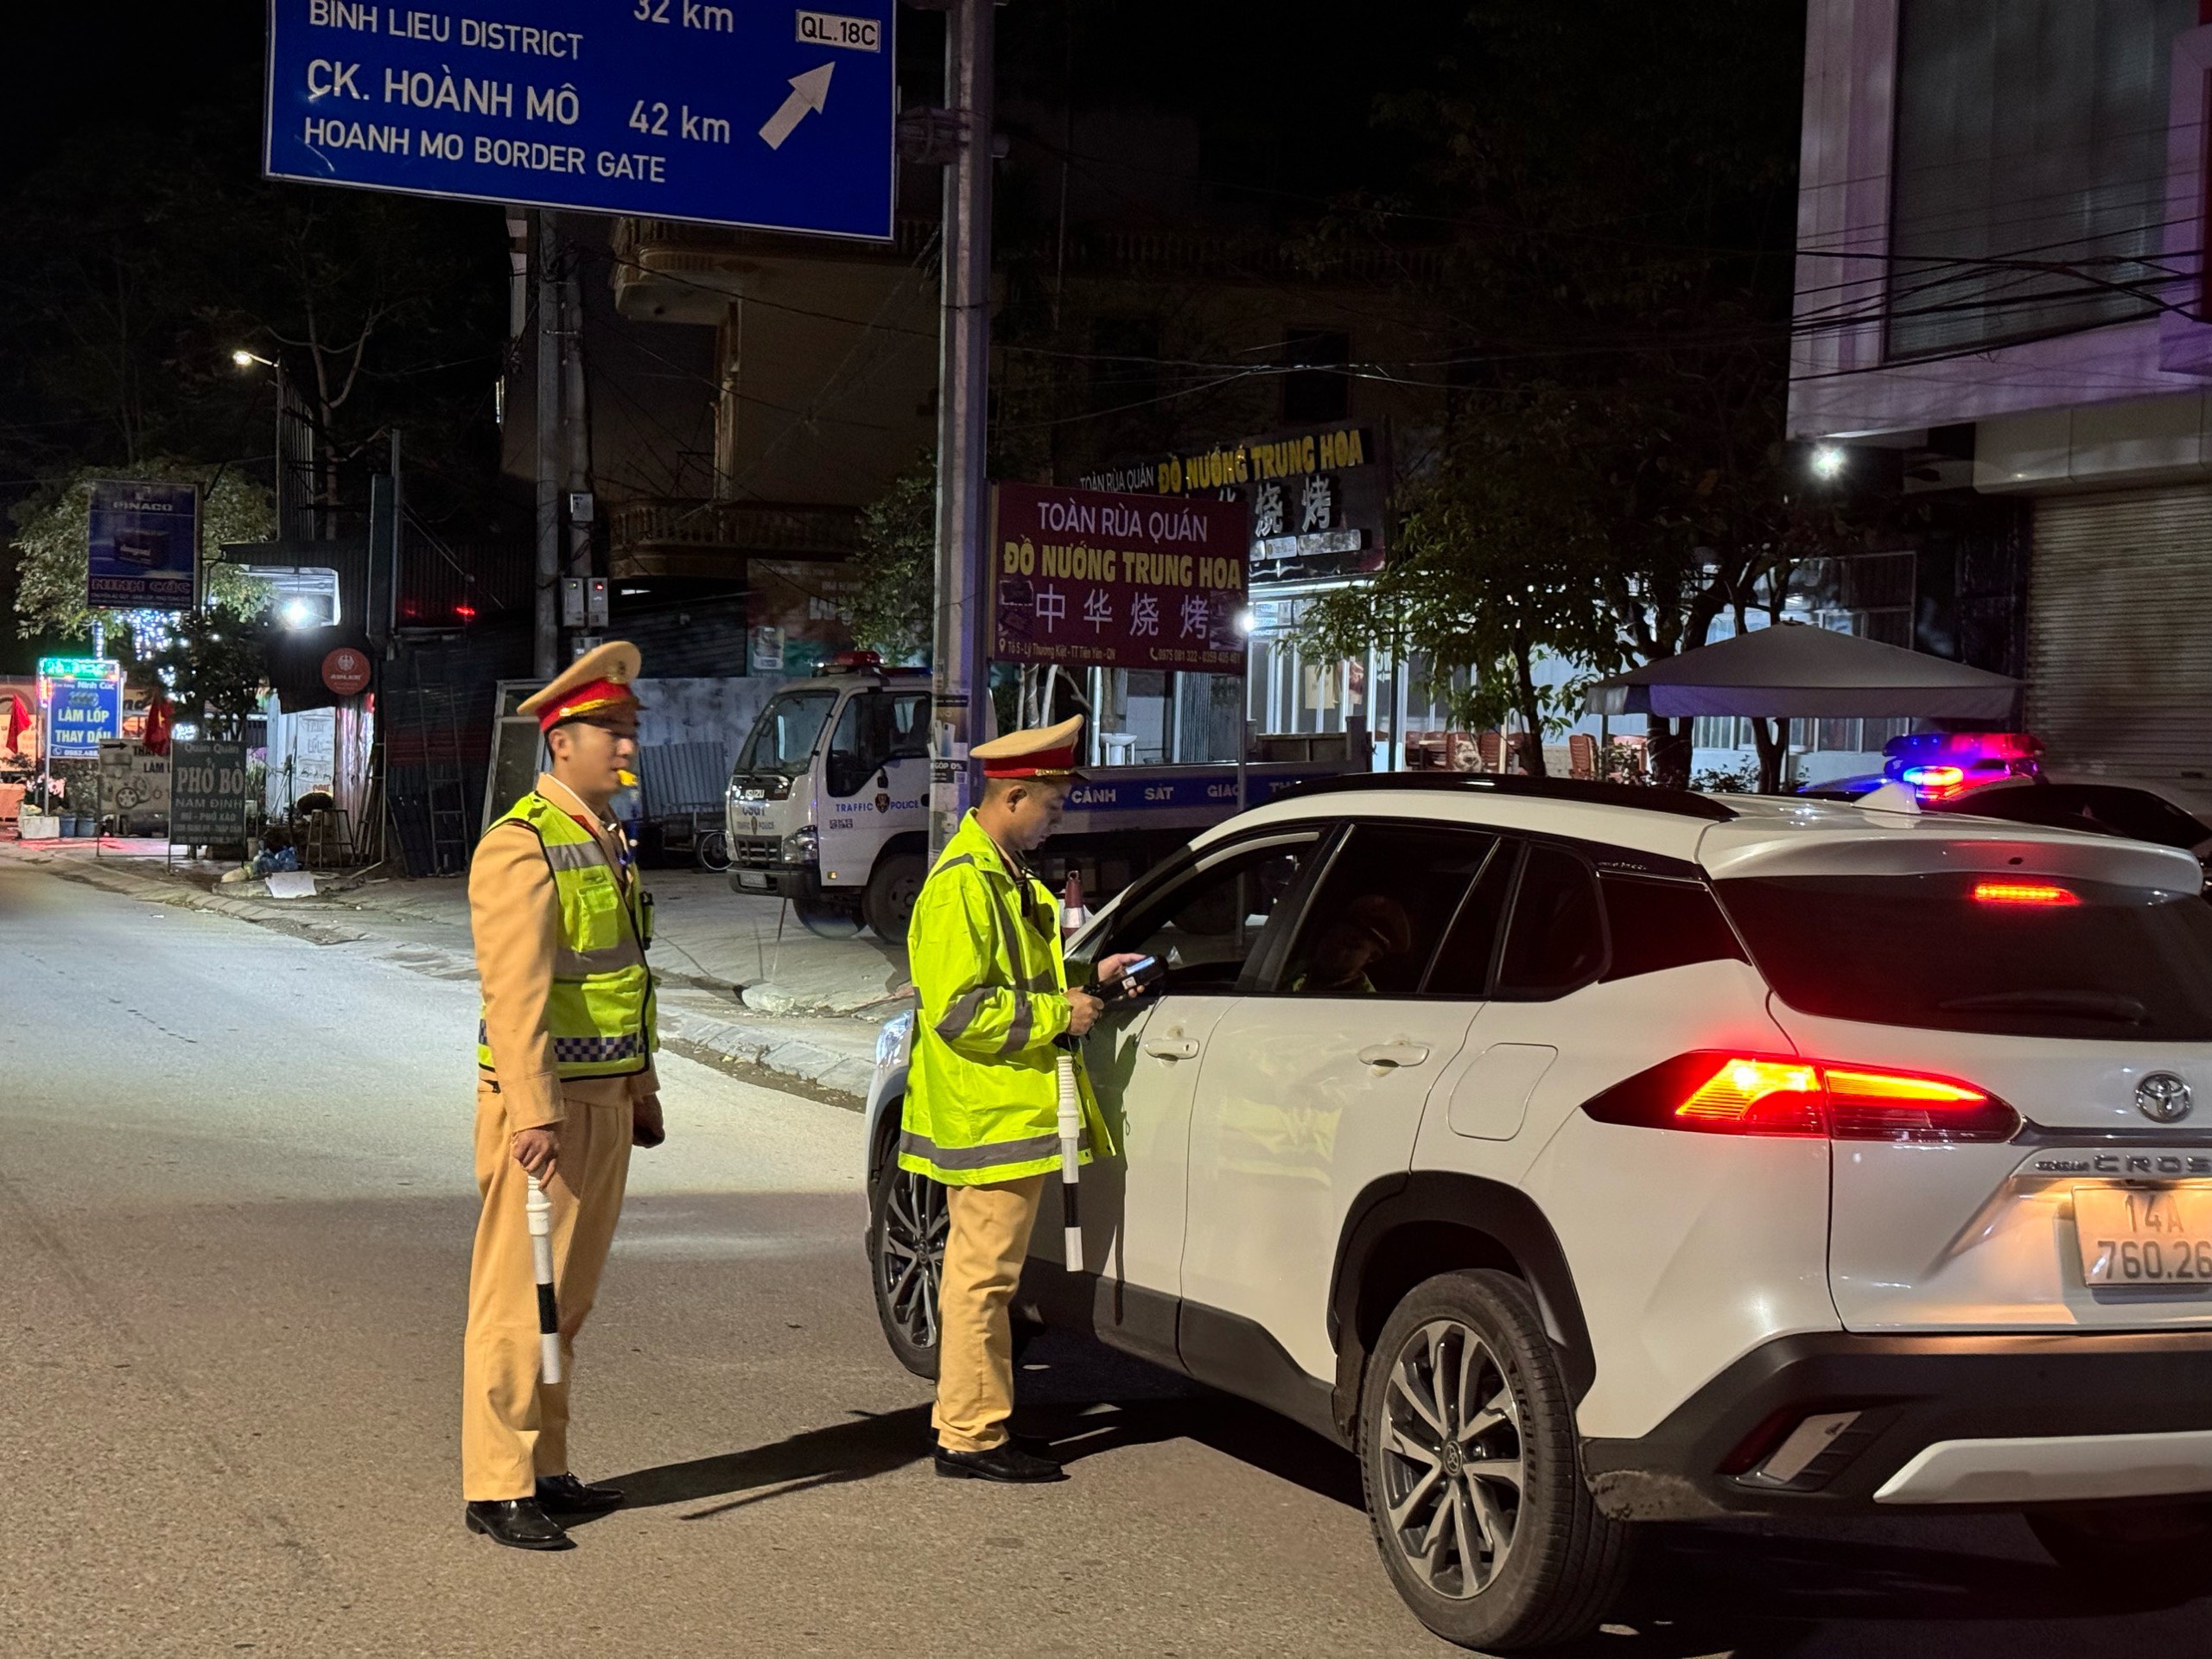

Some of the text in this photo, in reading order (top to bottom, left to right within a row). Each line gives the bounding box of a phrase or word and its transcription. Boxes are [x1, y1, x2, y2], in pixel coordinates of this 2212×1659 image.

[309, 0, 584, 60] BINH LIEU DISTRICT
[633, 0, 734, 33] 32 km
[801, 16, 876, 46] QL.18C
[307, 59, 579, 124] CK. HOÀNH MÔ
[629, 99, 731, 143] 42 km
[305, 117, 666, 182] HOANH MO BORDER GATE
[1127, 462, 1154, 493] QUÁN
[1251, 435, 1315, 480] TRUNG
[1319, 429, 1363, 468] HOA
[1038, 497, 1208, 544] TOÀN RÙA QUÁN
[1003, 534, 1242, 590] ĐỒ NƯỚNG TRUNG HOA
[1037, 584, 1210, 639] 中华烧烤
[58, 705, 110, 723] LÀM LỐP
[55, 730, 85, 743] THAY
[219, 761, 245, 794] BÒ
[745, 789, 765, 798] ISUZU
[1071, 785, 1116, 804] CẢNH
[1145, 783, 1174, 801] SÁT
[836, 799, 919, 812] TRAFFIC POLICE
[2124, 1193, 2183, 1234] 14A
[2097, 1240, 2212, 1280] 760.26
